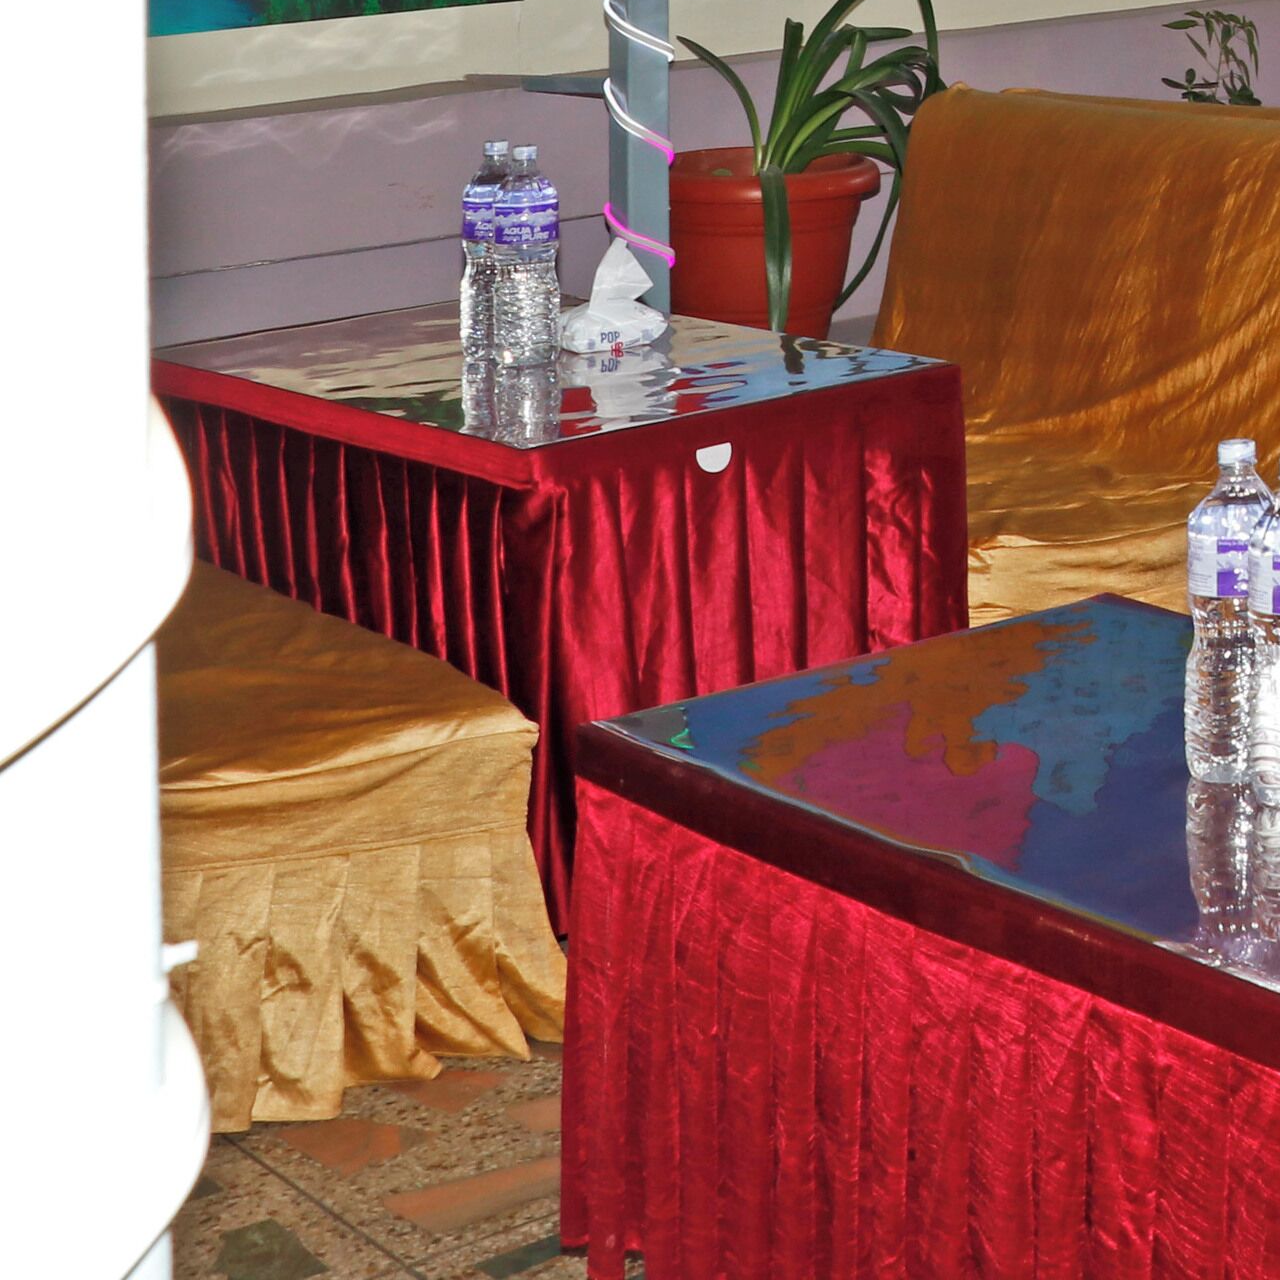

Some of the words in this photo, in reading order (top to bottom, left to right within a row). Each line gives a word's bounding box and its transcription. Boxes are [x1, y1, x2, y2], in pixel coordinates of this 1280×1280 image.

[503, 226, 532, 236] AQUA
[521, 231, 549, 241] PURE
[601, 331, 620, 344] POP
